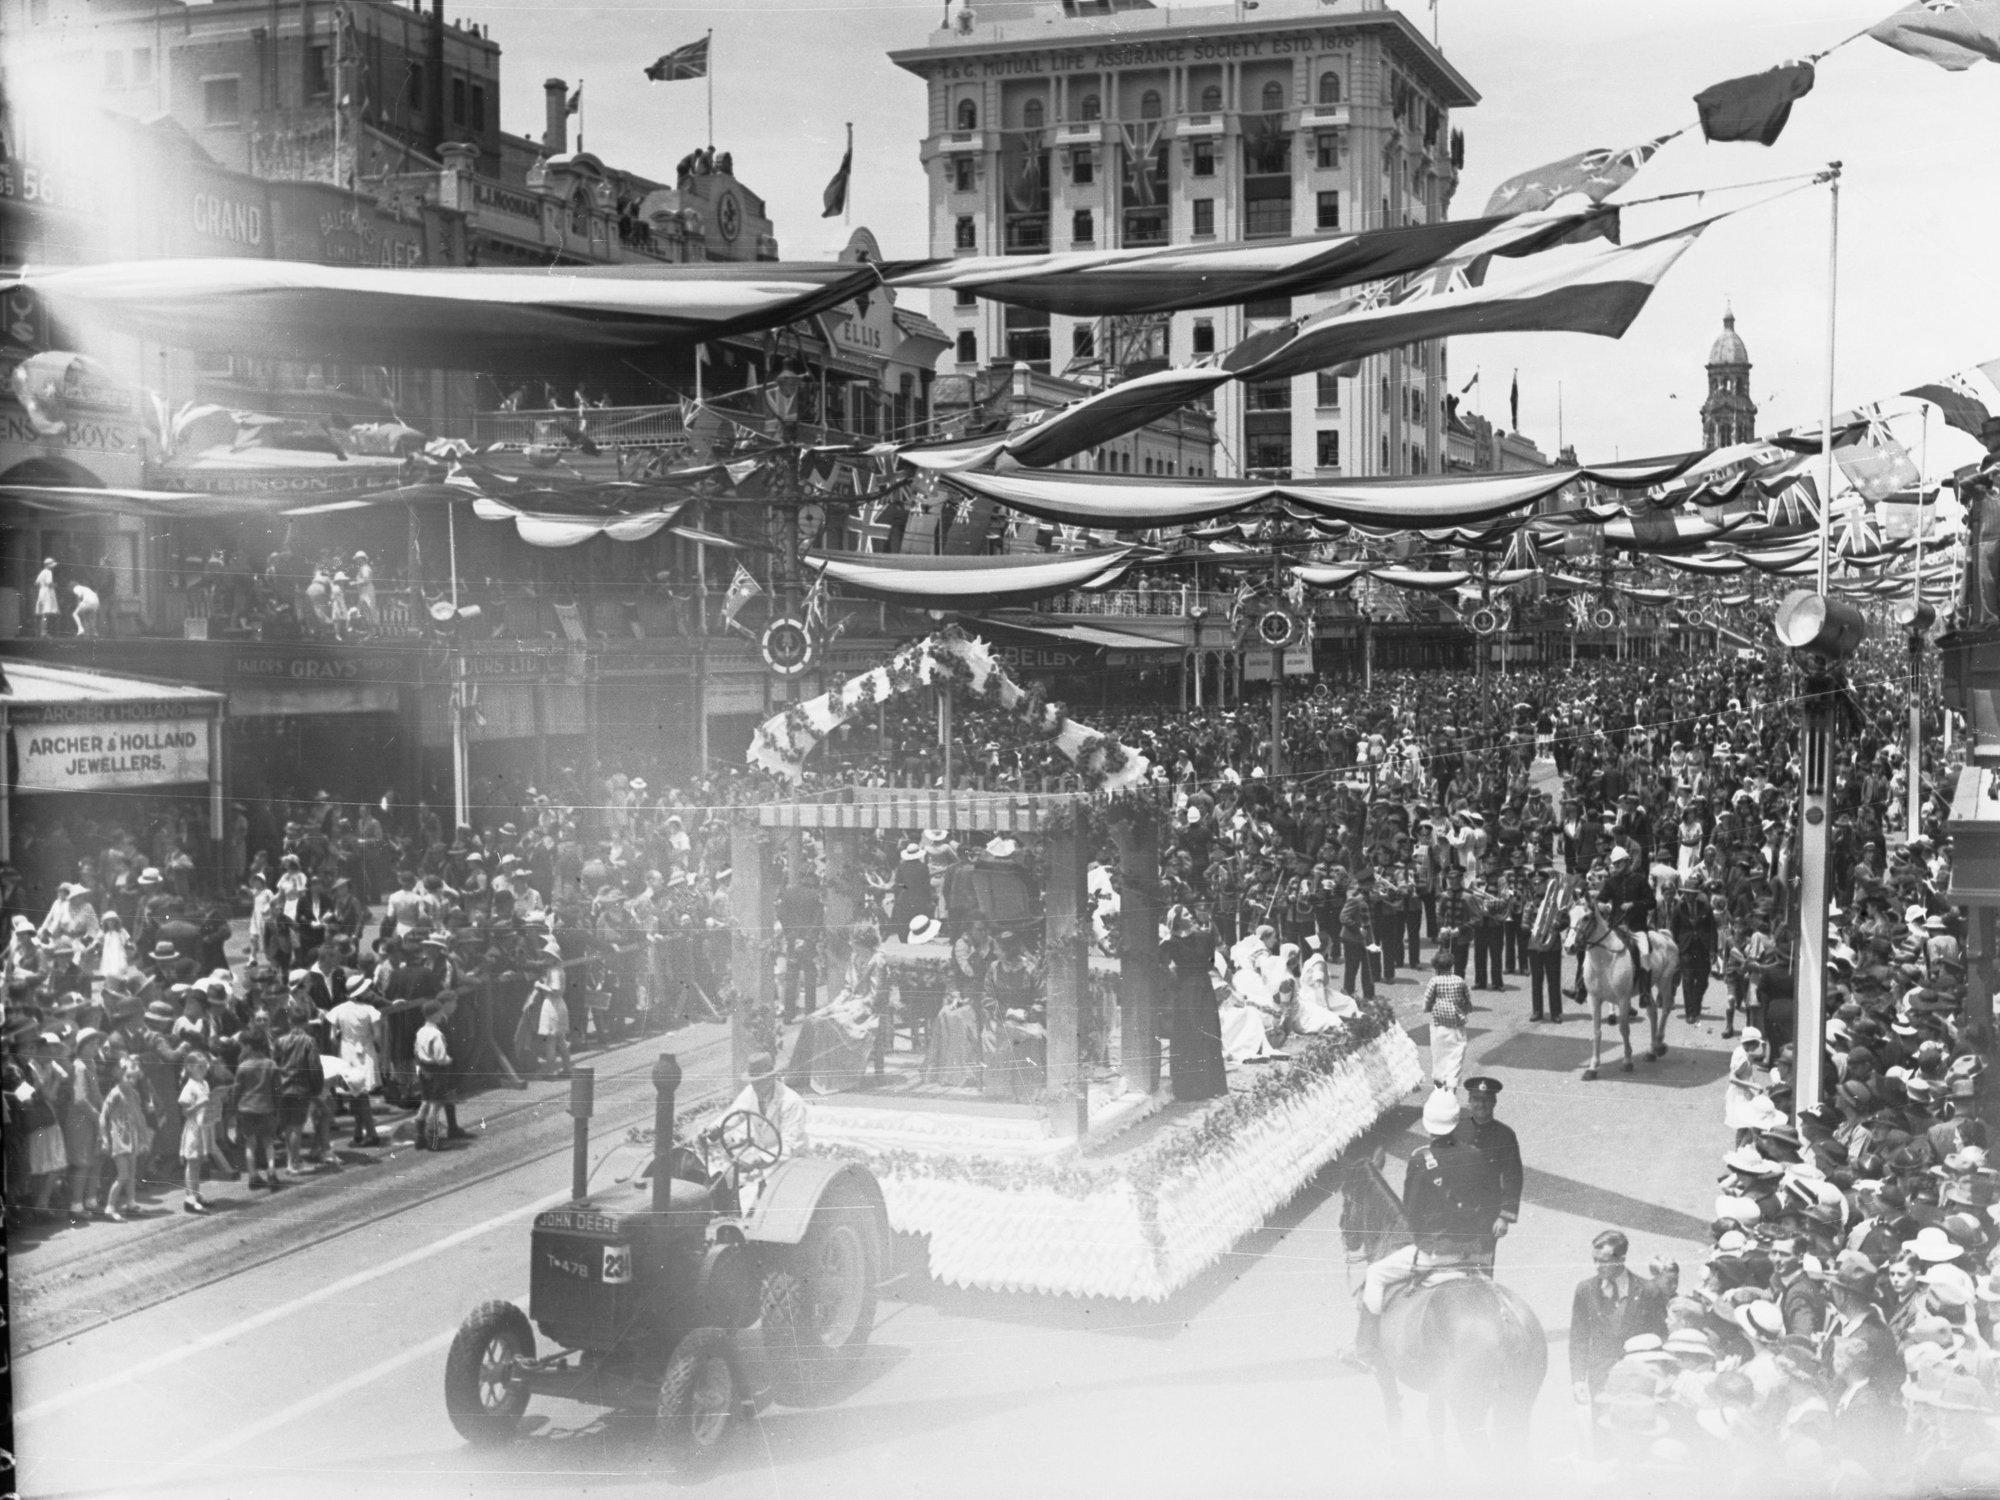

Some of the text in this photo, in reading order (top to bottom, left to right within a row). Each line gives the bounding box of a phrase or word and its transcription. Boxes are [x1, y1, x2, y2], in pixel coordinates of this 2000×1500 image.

[983, 56, 1043, 77] MUTUAL
[1051, 54, 1085, 72] LIFE
[1095, 46, 1186, 68] ASSURANCE
[193, 193, 262, 245] GRAND
[844, 321, 881, 348] ELLIS
[291, 660, 358, 678] GRAYS
[43, 705, 105, 723] ARCHER
[120, 702, 186, 720] HOLLAND
[29, 732, 196, 756] ARCHER & HOLLAND
[539, 1213, 620, 1233] JOHN DEERE
